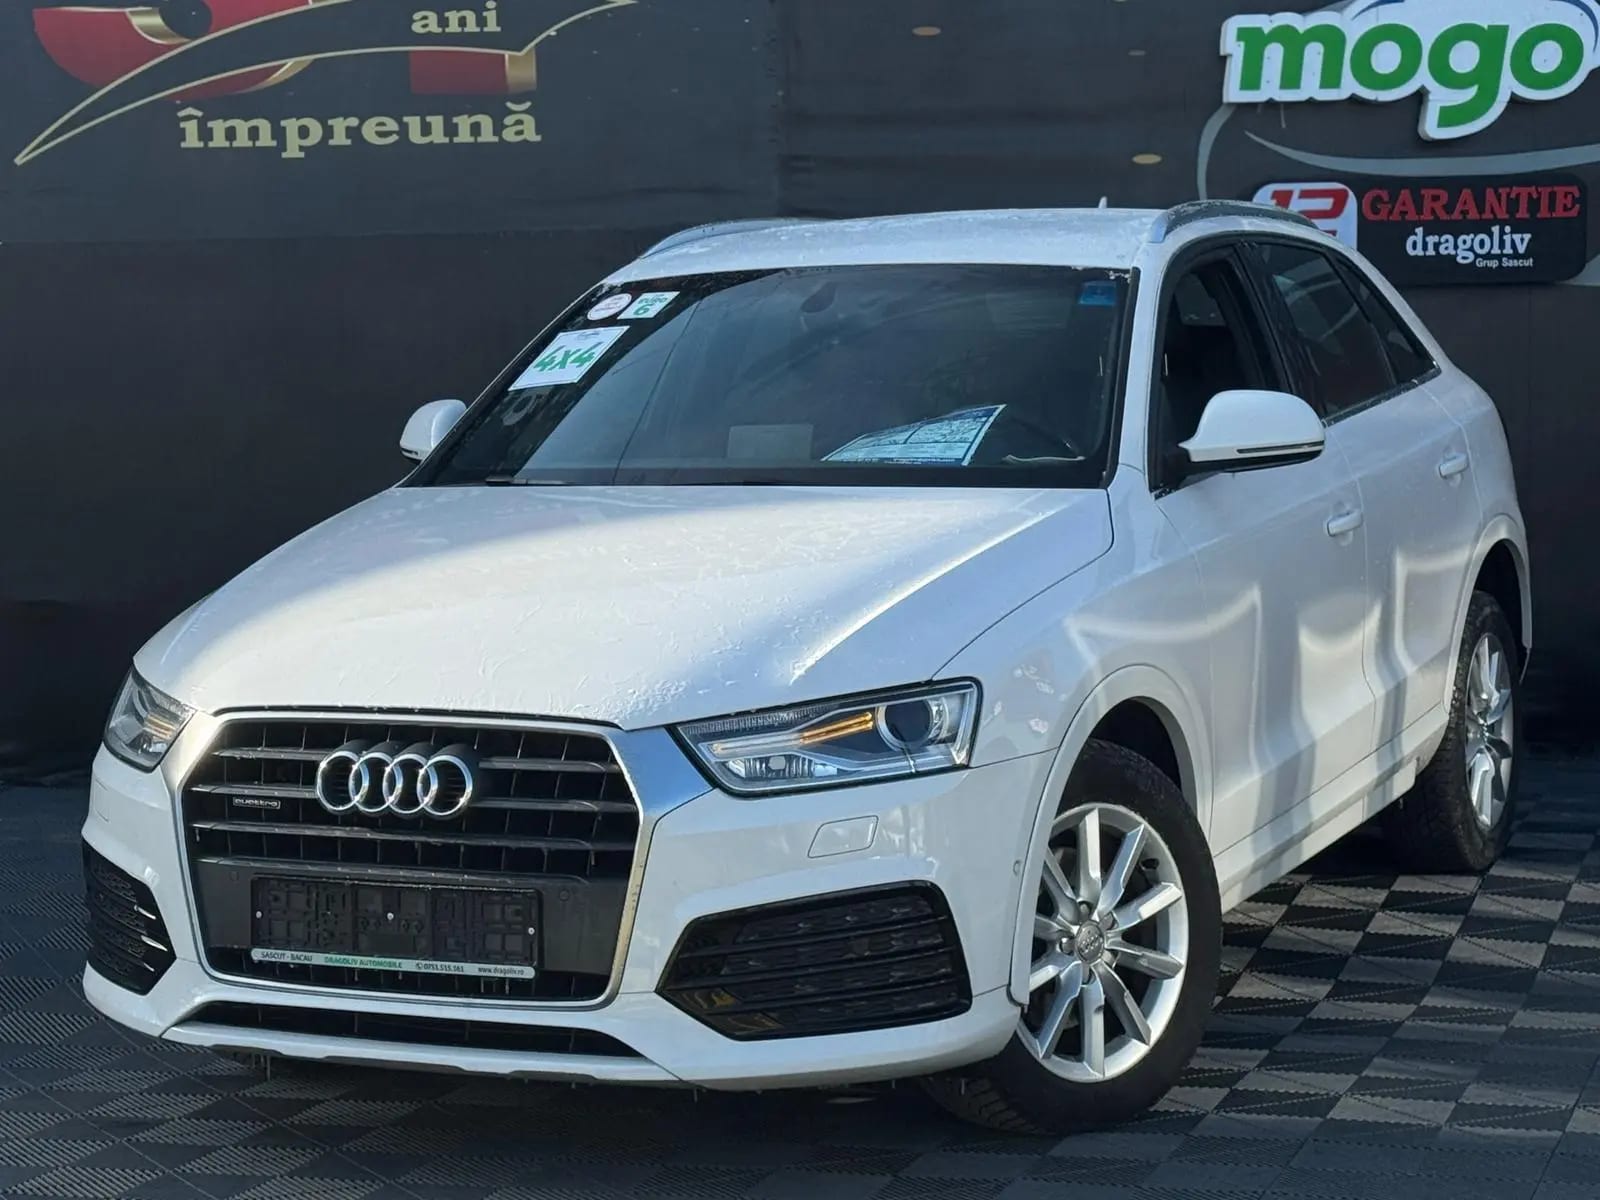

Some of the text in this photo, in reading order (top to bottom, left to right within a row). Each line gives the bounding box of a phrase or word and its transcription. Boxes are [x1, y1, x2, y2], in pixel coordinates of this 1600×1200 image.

[411, 1, 502, 33] ani
[1236, 23, 1584, 128] mogo
[177, 101, 542, 158] împreună
[1362, 185, 1581, 222] GARANTIE
[1405, 225, 1532, 264] dragoliv
[1475, 256, 1534, 269] Grup Sascut
